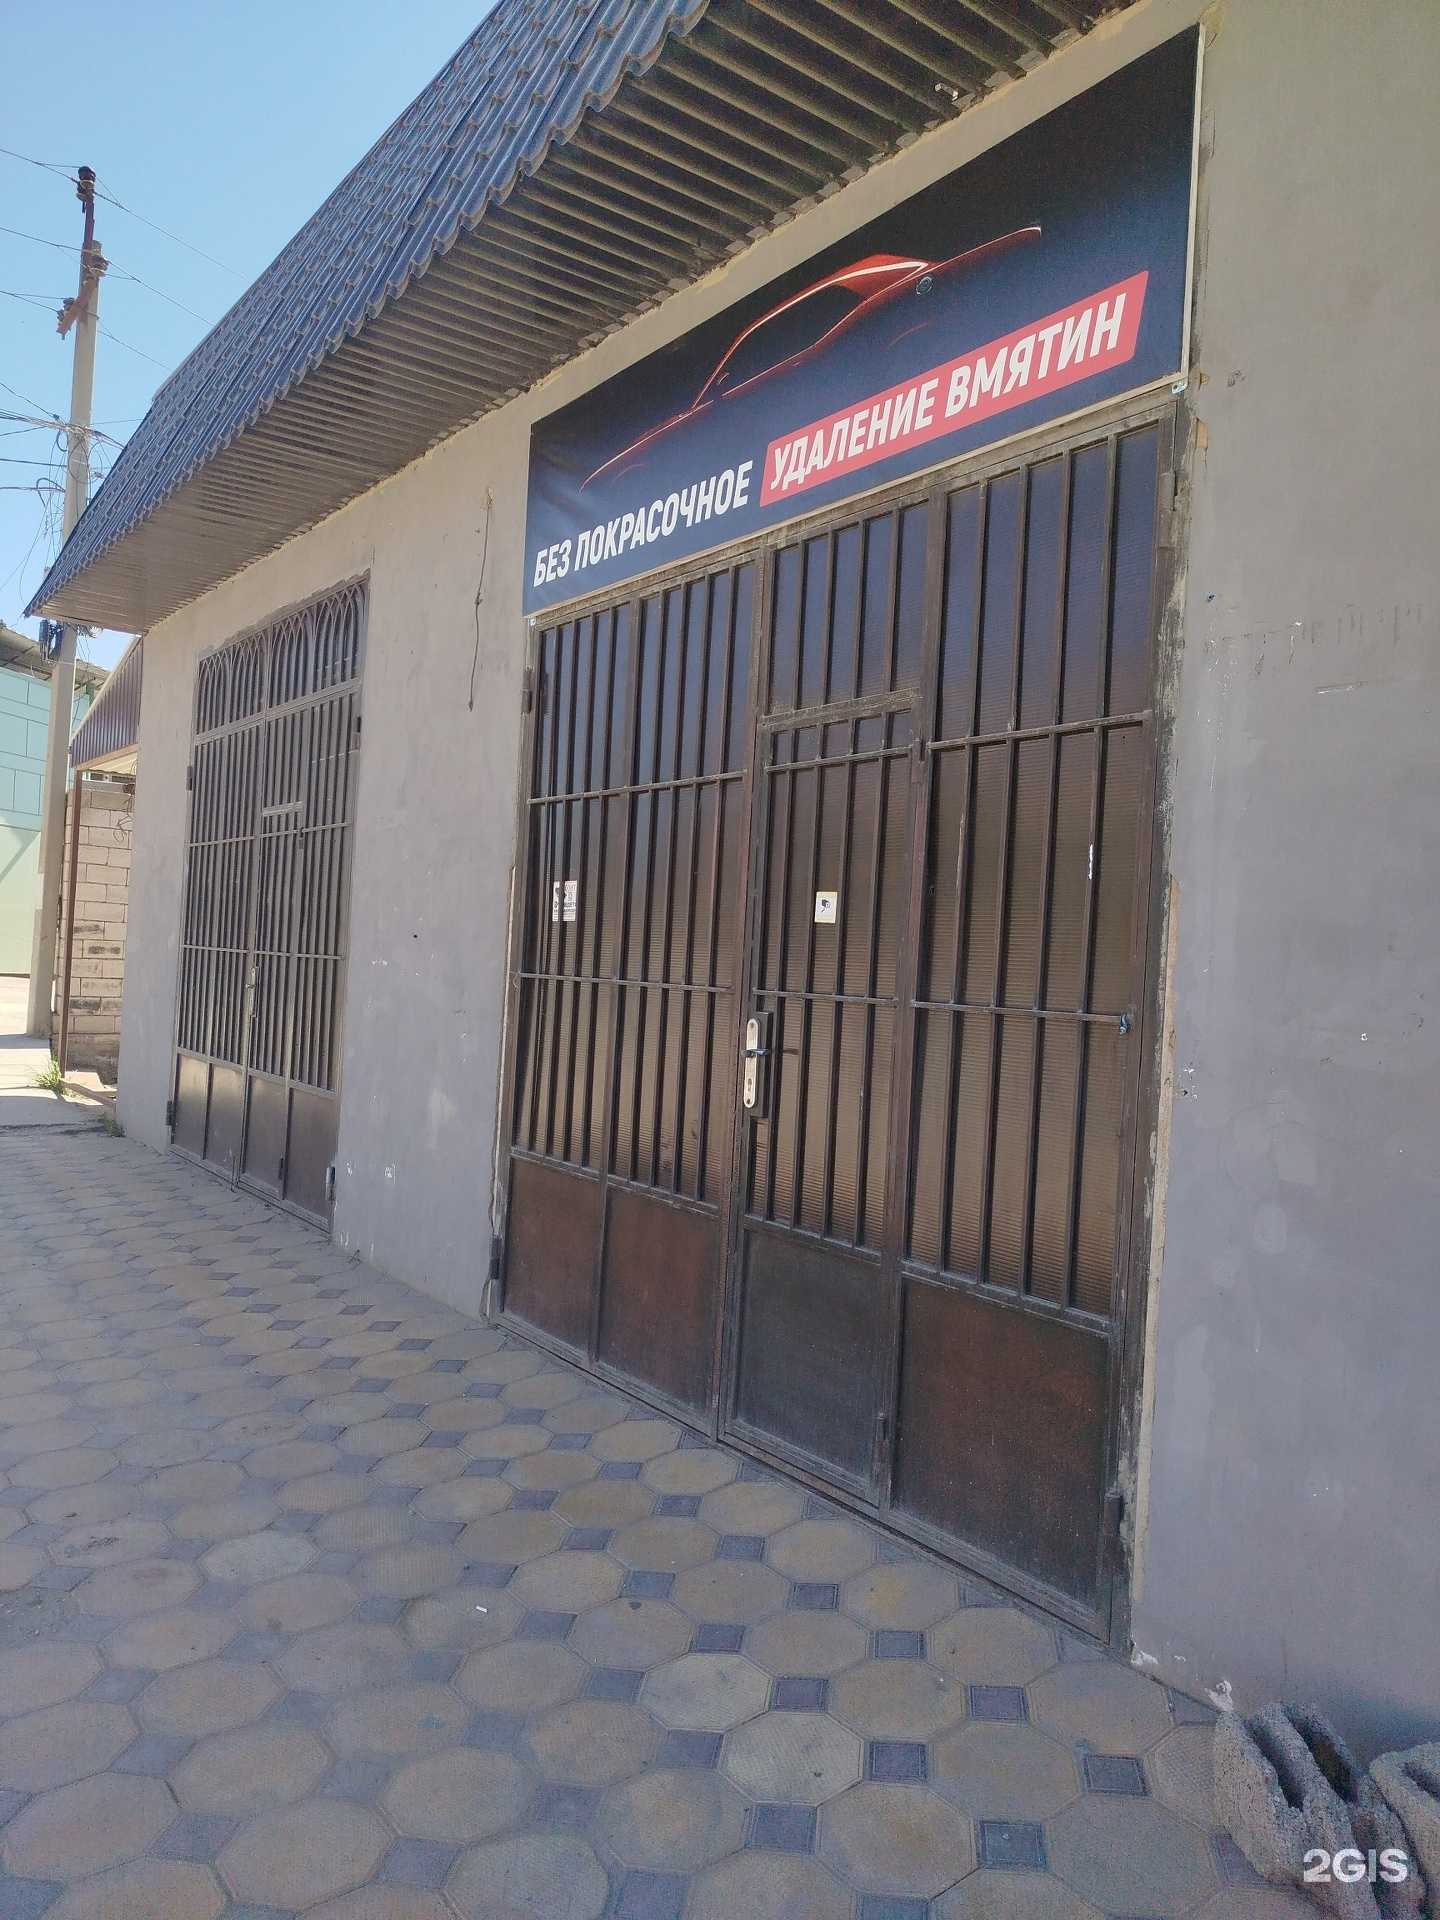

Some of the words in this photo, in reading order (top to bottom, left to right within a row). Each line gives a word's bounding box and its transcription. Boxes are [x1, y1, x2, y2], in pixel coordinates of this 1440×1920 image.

[533, 539, 572, 588] БЕЗ
[574, 460, 753, 571] ПОКРАСОЧНОЕ
[770, 378, 939, 491] УДАЛЕНИЕ
[945, 293, 1127, 418] ВМЯТИН
